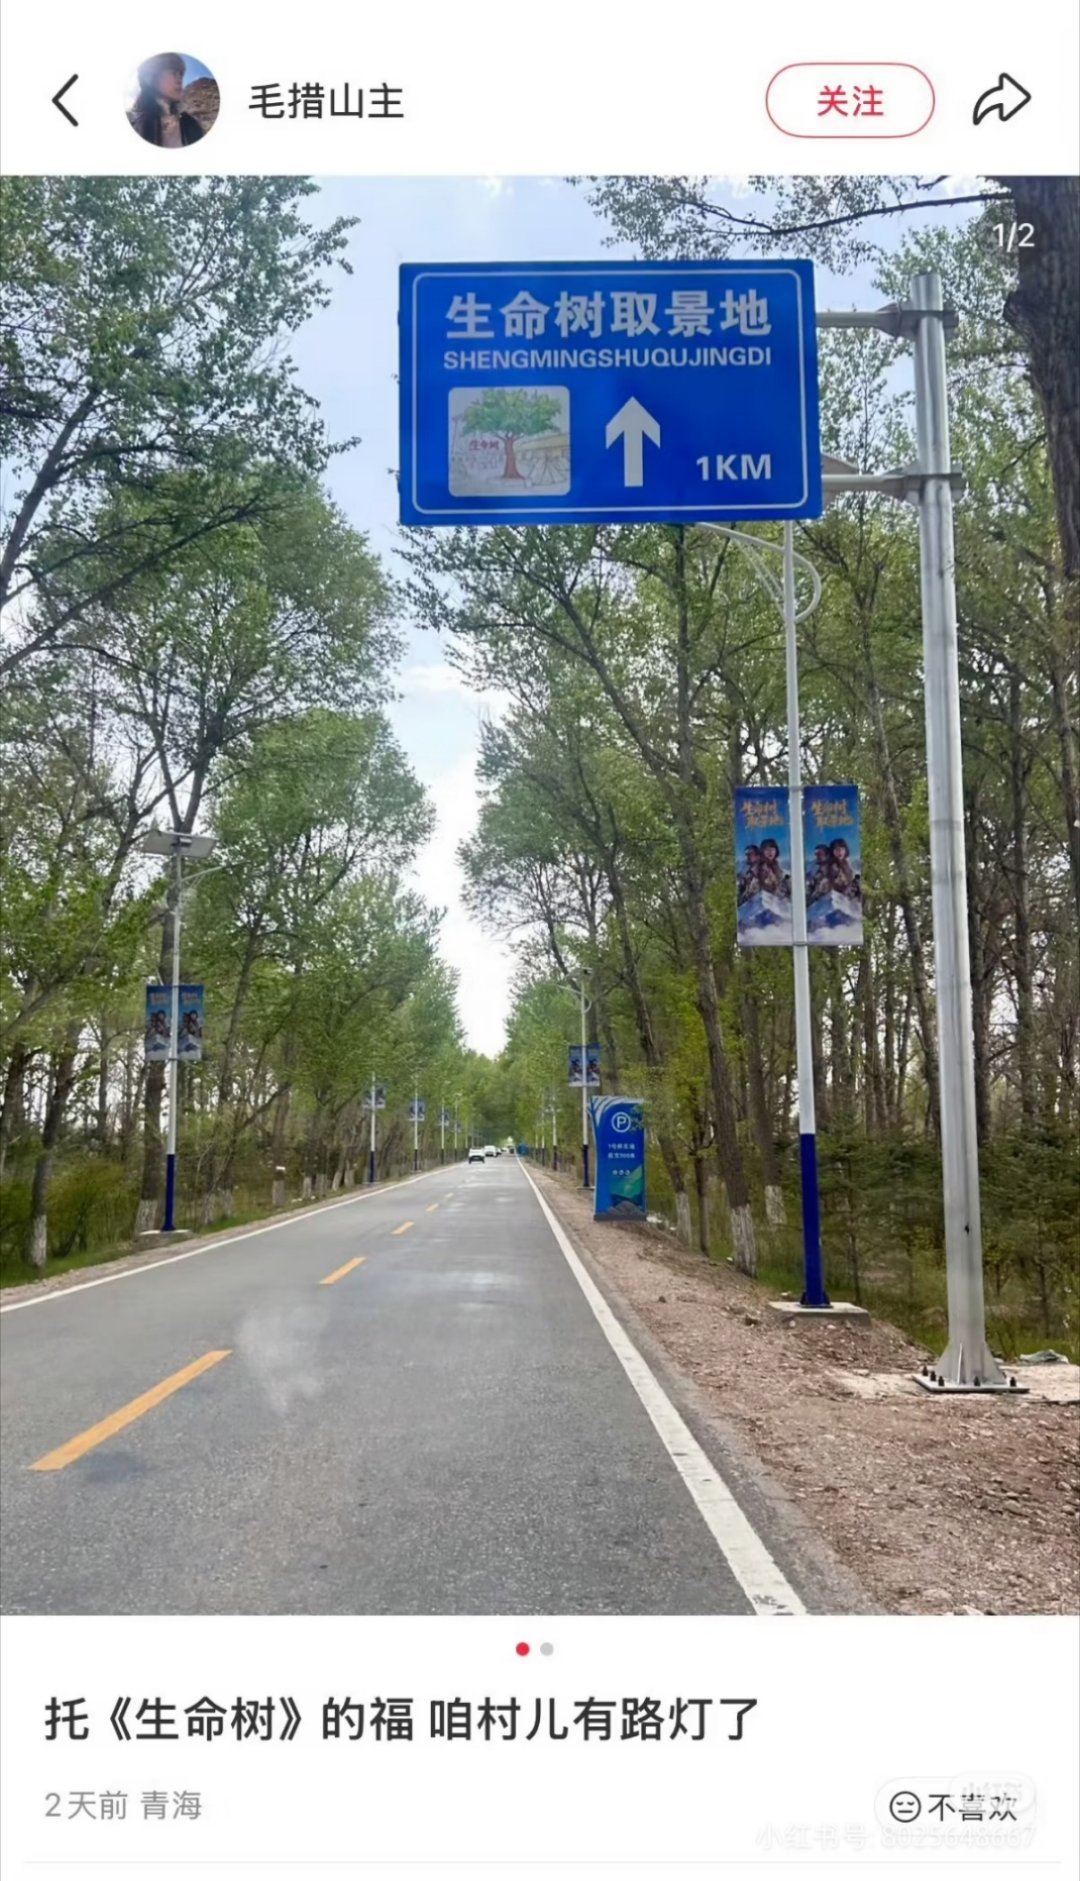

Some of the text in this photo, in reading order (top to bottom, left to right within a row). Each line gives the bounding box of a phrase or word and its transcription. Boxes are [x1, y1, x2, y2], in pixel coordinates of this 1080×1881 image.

[446, 289, 772, 339] 生命树取景地
[443, 347, 772, 369] SHENGMINGSHUQUJINGDI
[696, 454, 772, 481] 1KM
